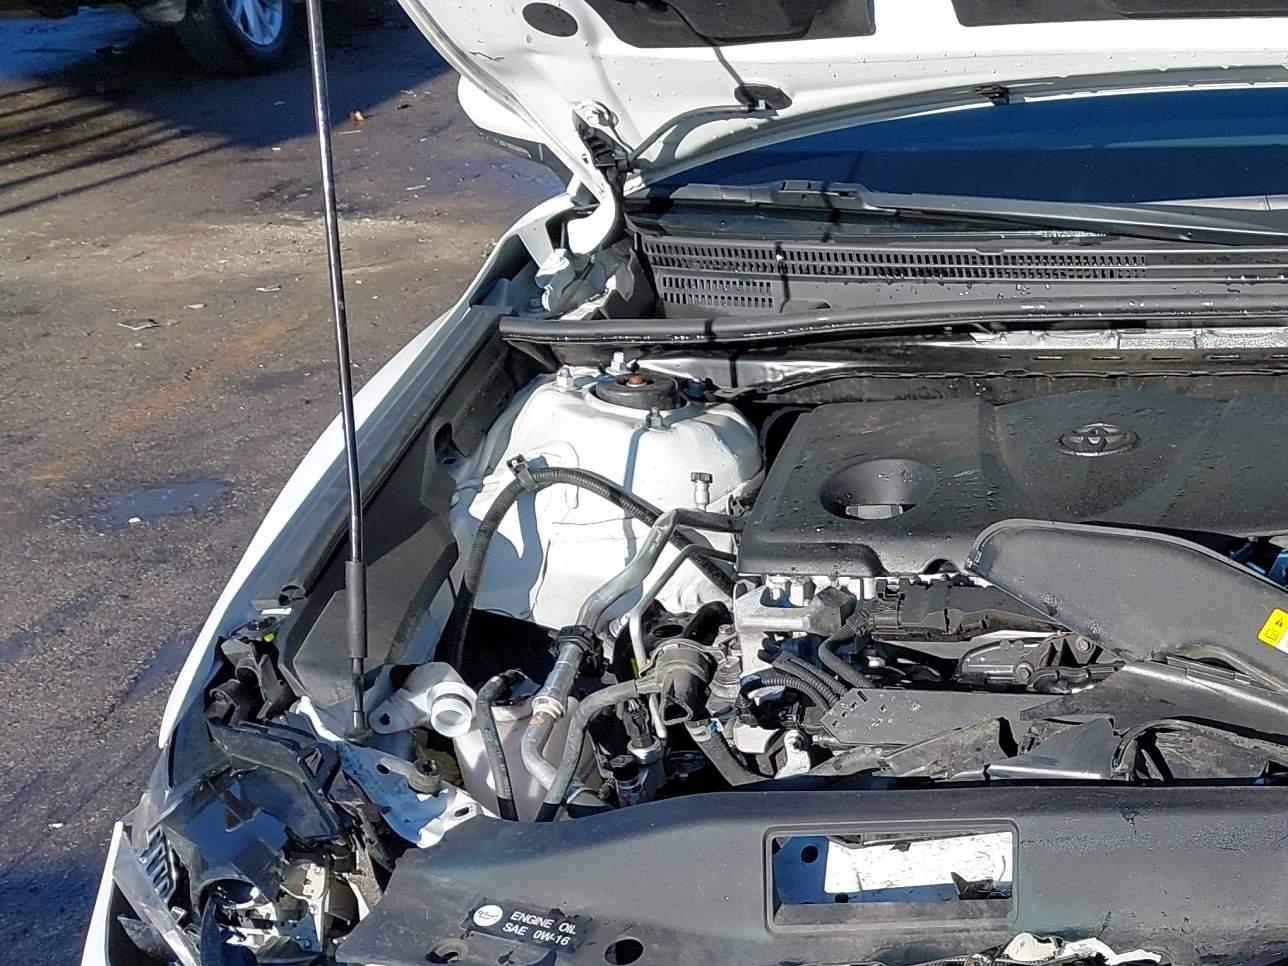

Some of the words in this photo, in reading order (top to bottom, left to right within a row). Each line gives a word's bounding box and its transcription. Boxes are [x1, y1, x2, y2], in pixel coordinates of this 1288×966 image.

[503, 923, 529, 936] SAE
[534, 931, 570, 946] 0W-16
[510, 911, 555, 929] ENGINE
[559, 923, 576, 935] OIL
